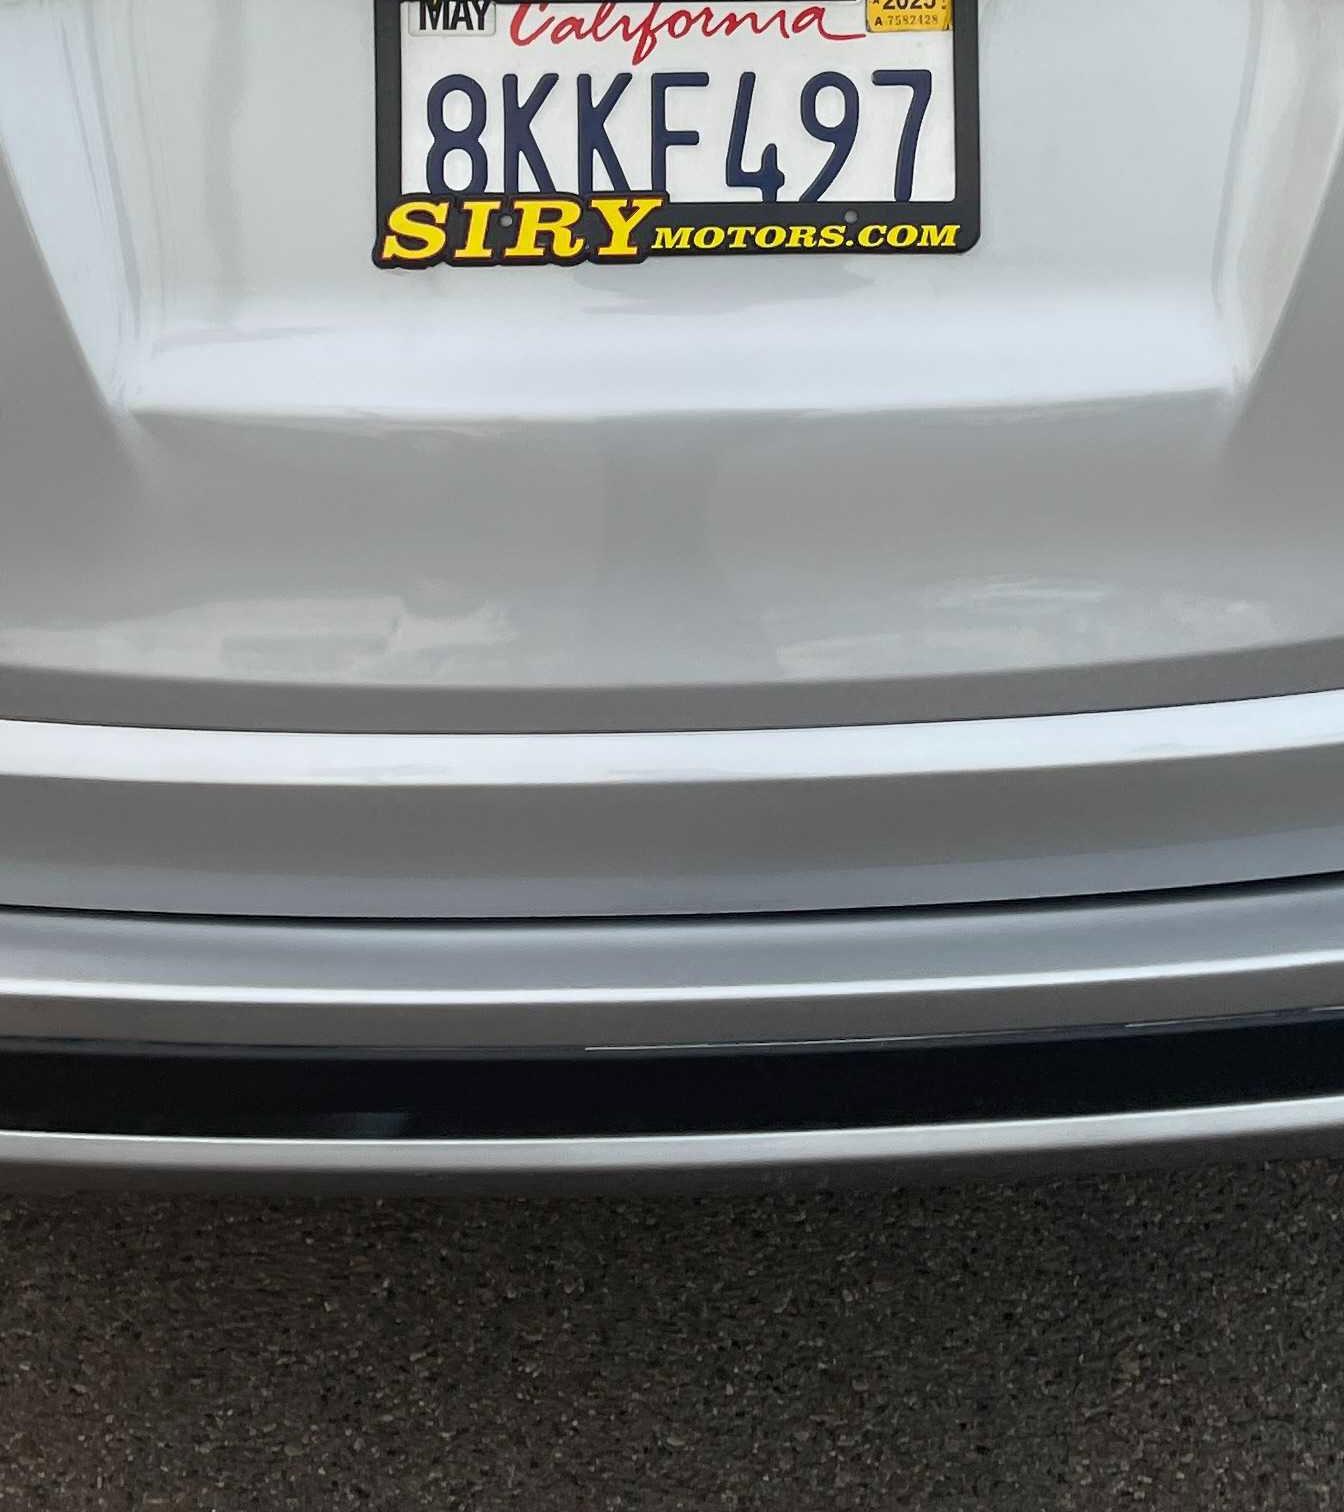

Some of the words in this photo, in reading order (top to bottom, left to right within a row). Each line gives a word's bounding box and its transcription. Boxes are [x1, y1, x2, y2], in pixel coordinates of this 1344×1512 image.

[418, 0, 492, 30] MAY
[510, 0, 867, 66] California
[426, 69, 933, 203] 8KKF497
[382, 198, 663, 261] SIRY
[650, 224, 961, 250] MOTORS.COM
